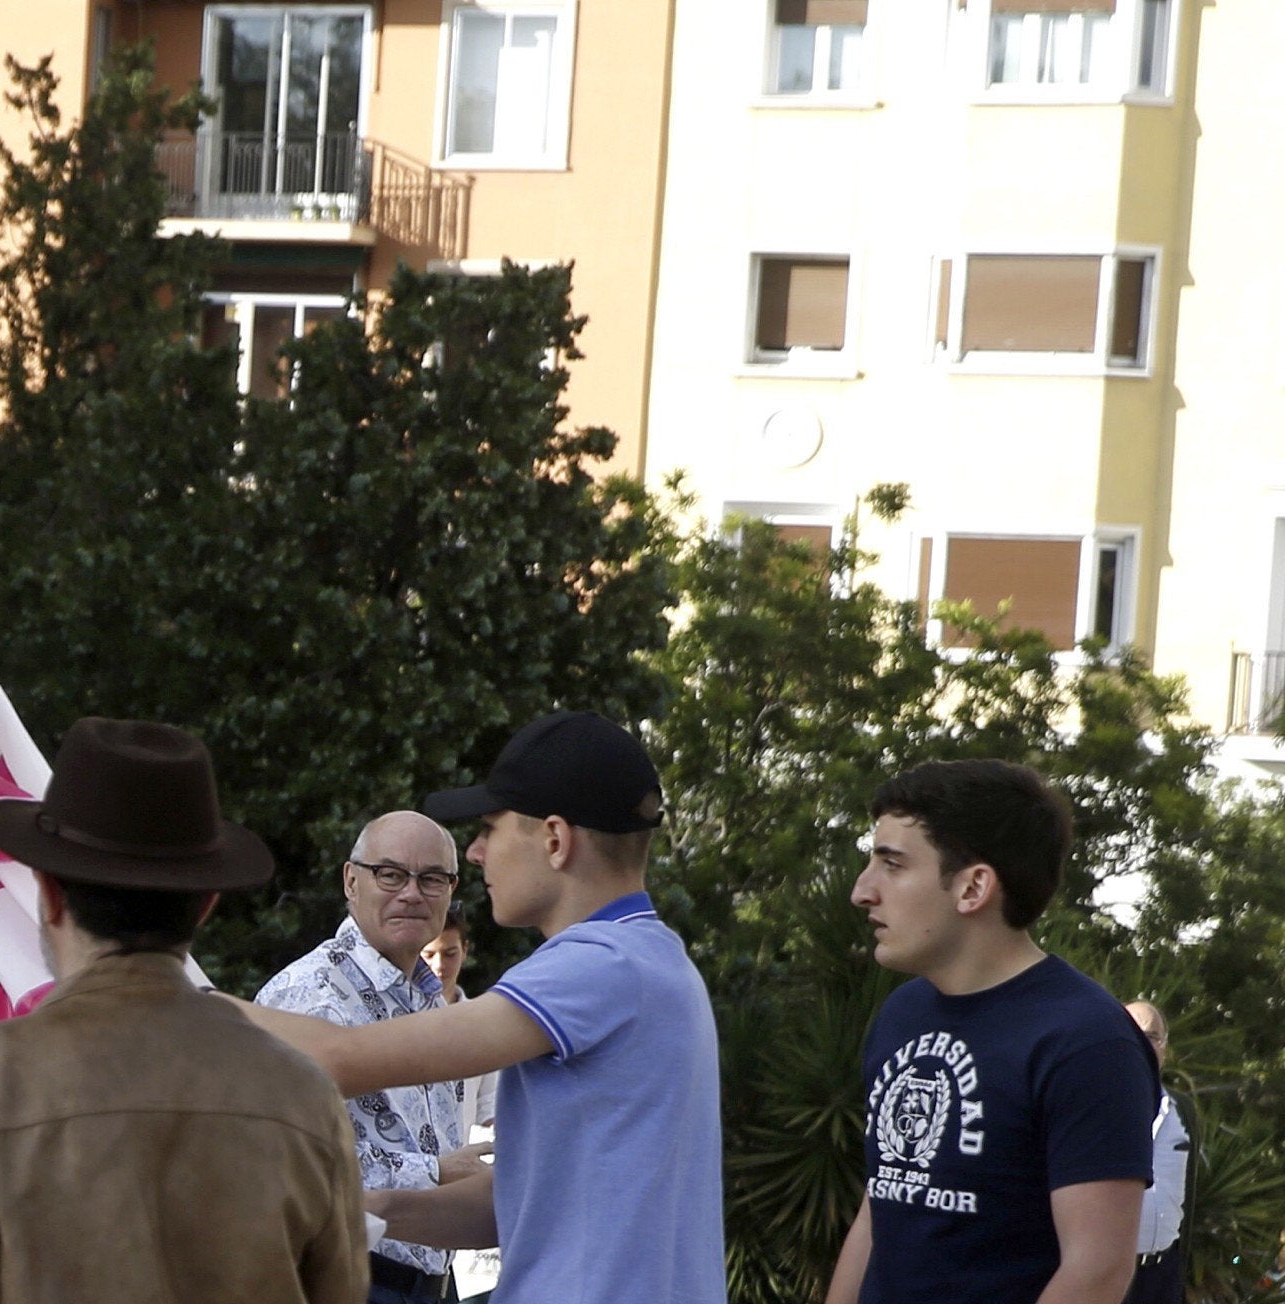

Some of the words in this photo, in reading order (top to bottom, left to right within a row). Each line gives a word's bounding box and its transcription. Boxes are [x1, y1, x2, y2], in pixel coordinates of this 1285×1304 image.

[877, 1165, 903, 1180] EST.
[903, 1169, 930, 1186] 1943
[924, 1187, 978, 1213] BOR
